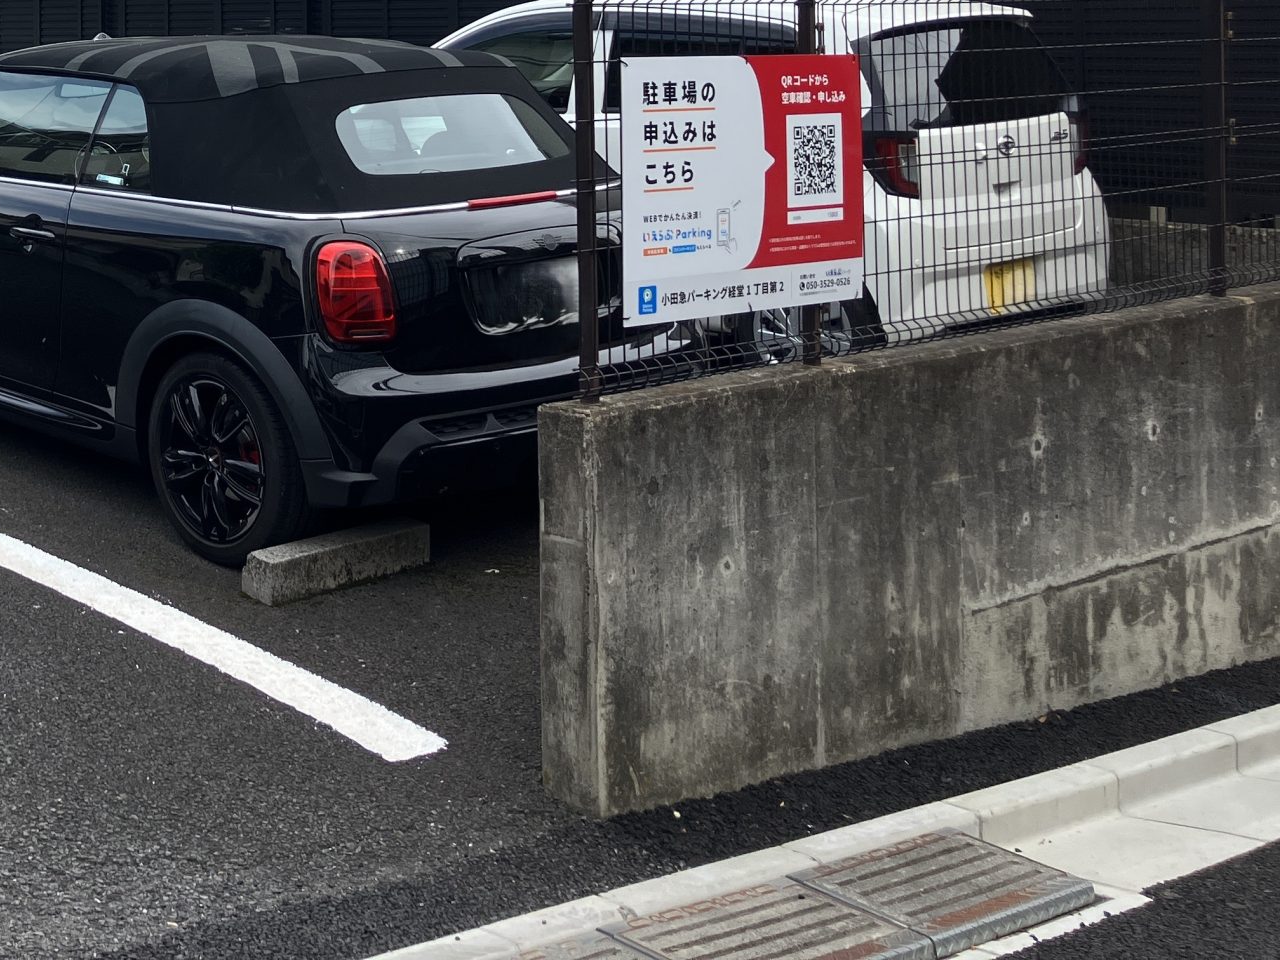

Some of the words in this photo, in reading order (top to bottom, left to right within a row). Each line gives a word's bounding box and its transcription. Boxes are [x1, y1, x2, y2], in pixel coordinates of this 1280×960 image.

[781, 74, 829, 88] QRコードから
[642, 81, 716, 106] 駐車場の
[643, 120, 717, 146] 申込みは
[645, 161, 694, 184] こちら
[675, 227, 712, 240] Parking
